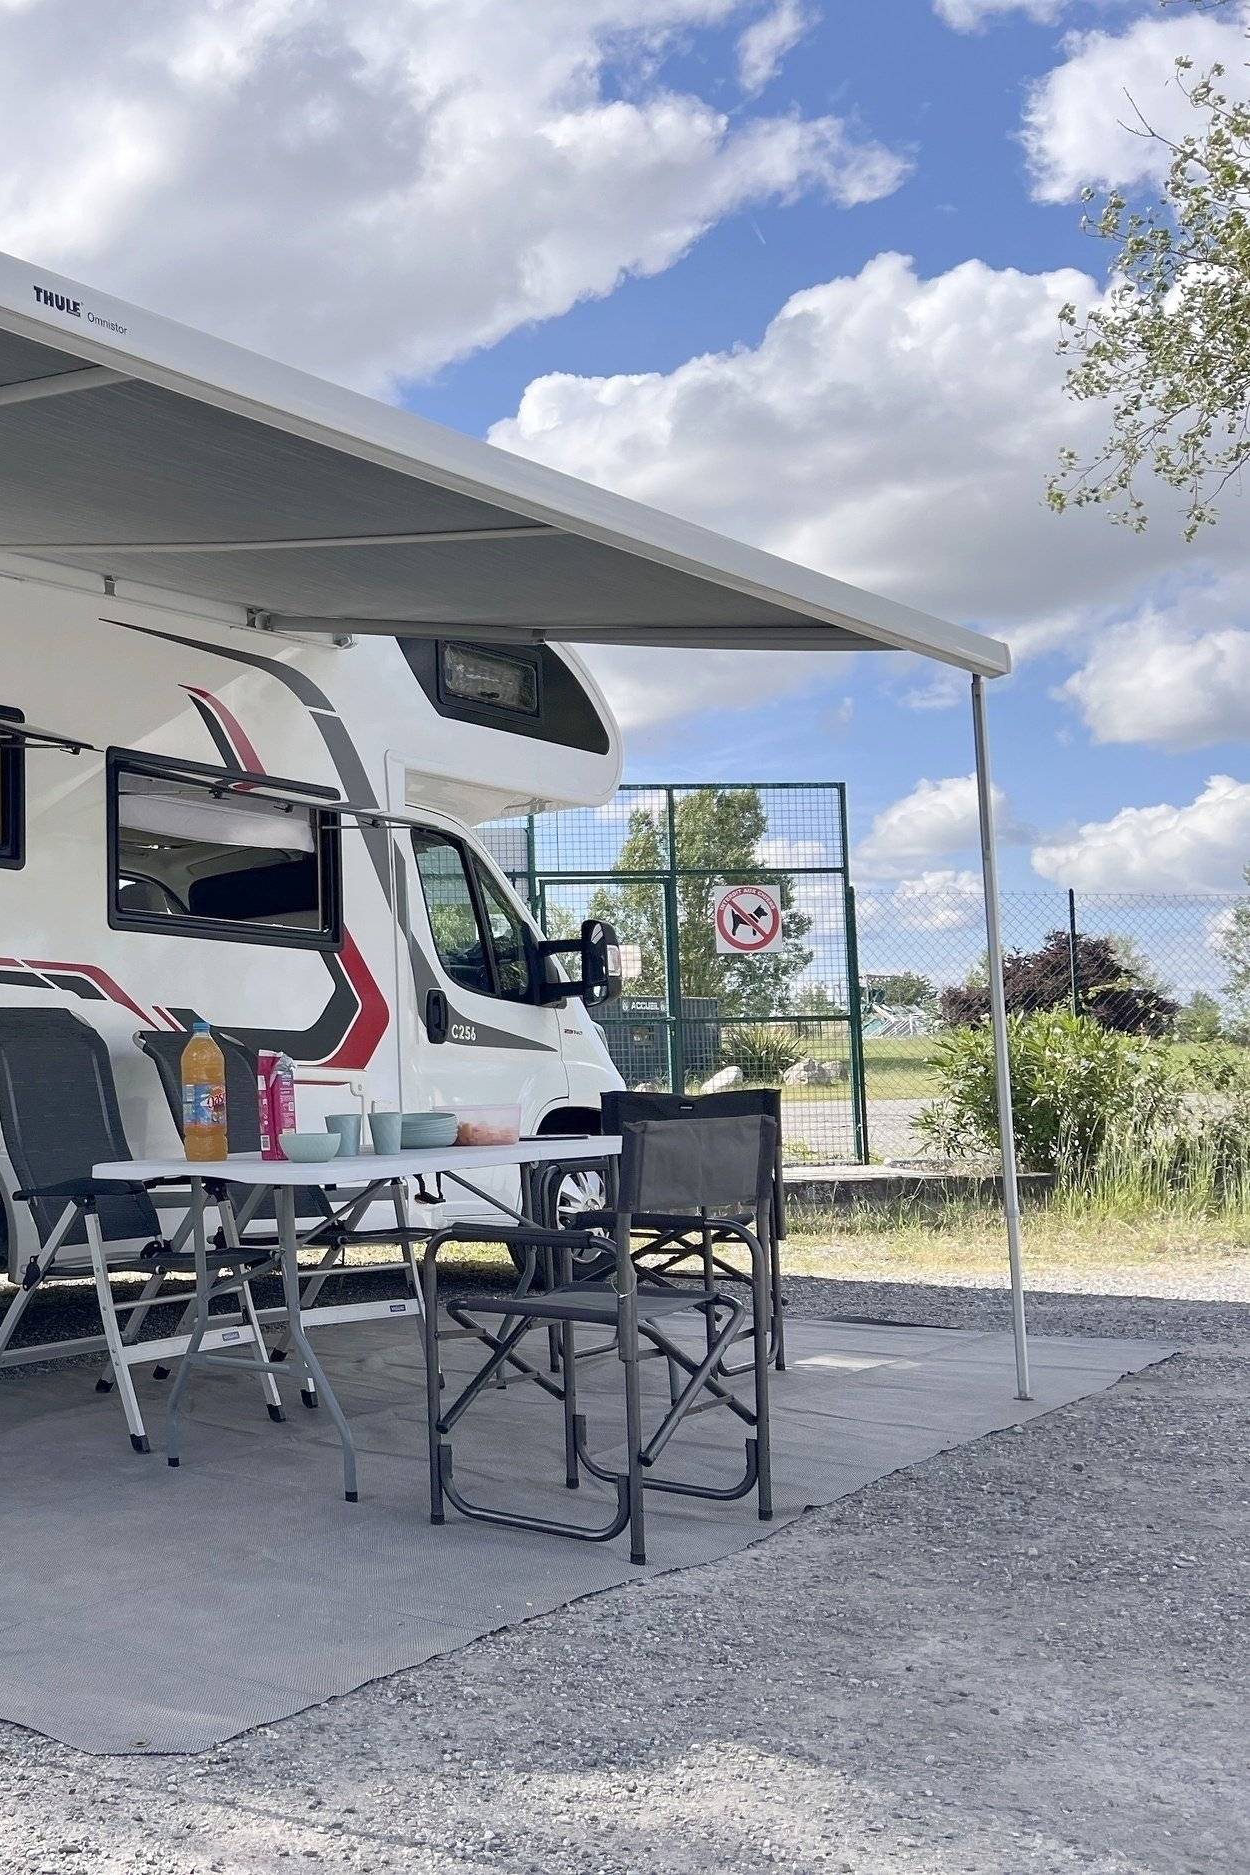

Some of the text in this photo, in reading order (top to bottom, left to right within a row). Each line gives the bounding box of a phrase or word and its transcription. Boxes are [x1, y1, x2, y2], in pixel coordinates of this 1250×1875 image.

[33, 285, 128, 335] THULE Omnistor
[631, 1001, 660, 1010] ACCUEIL
[451, 1023, 477, 1042] C256
